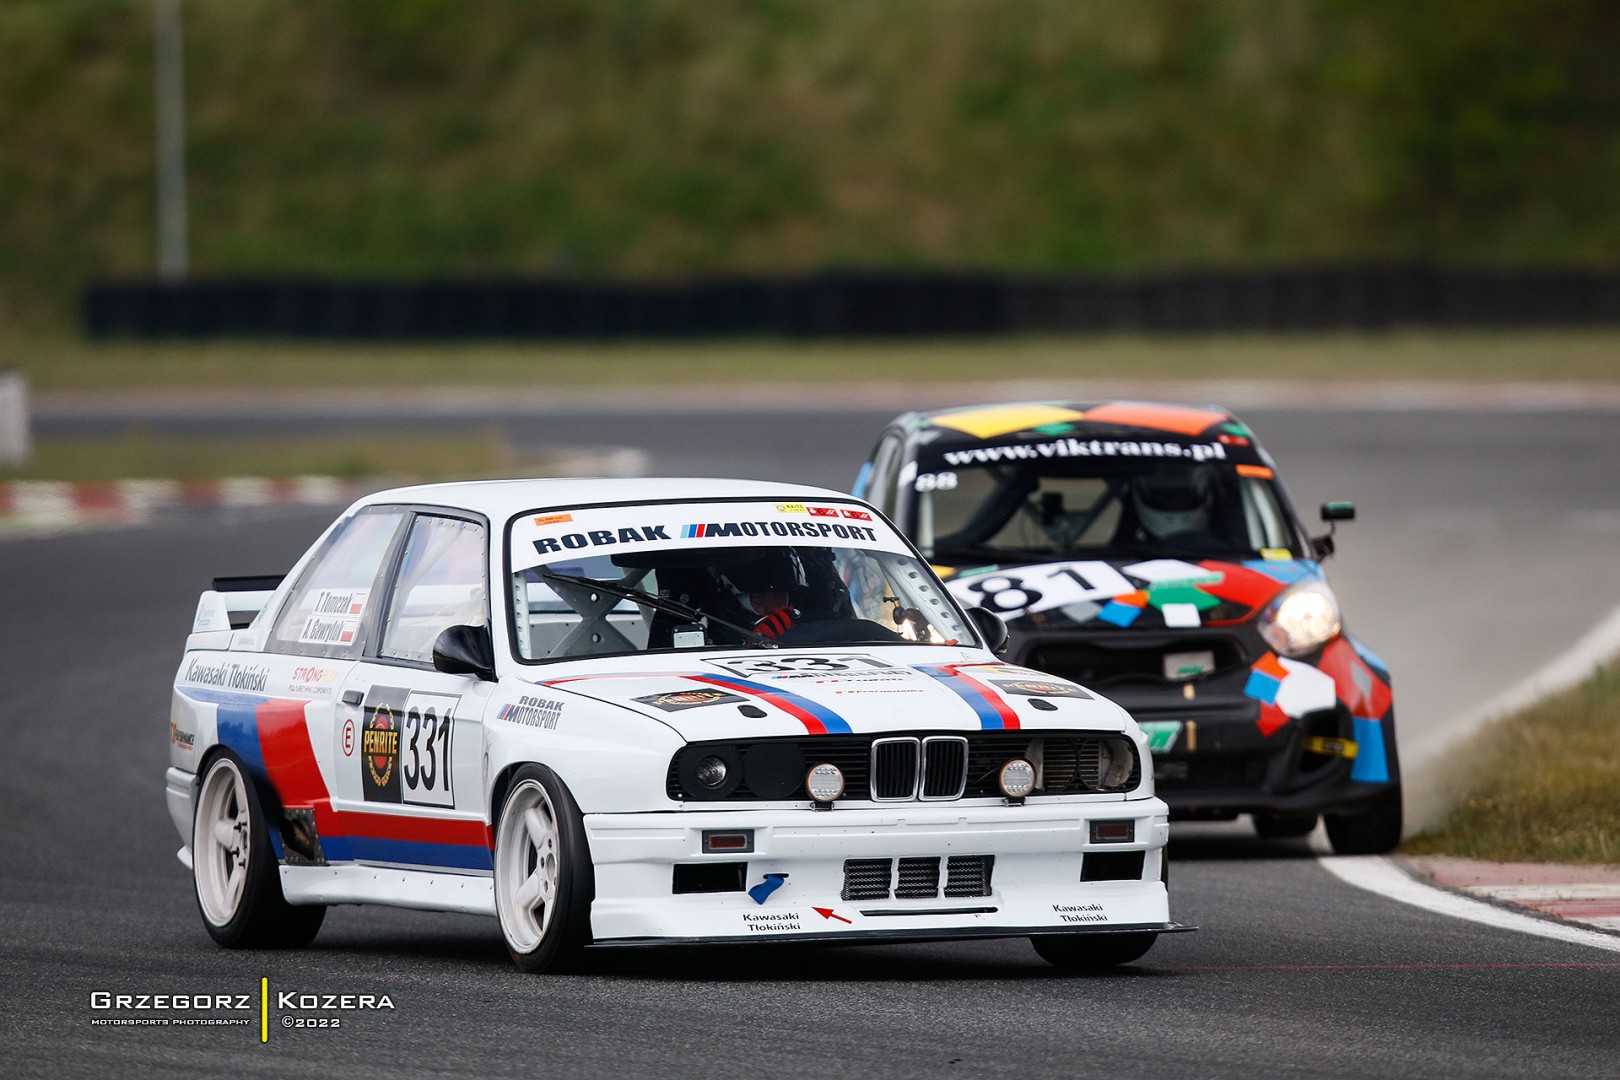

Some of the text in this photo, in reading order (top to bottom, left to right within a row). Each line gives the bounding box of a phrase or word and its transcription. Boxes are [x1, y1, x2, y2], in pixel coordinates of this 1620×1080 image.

[943, 438, 1227, 463] www.viktrans.pl
[914, 472, 958, 492] 88
[532, 521, 878, 555] ROBAK MOTORSPORT
[967, 565, 1097, 613] 81
[320, 592, 354, 614] Tomczak
[184, 657, 271, 692] Kawasaki Tłokiński
[727, 656, 895, 673] 331
[518, 695, 565, 711] ROBAK
[503, 703, 563, 730] MOTORSPORT
[345, 727, 352, 749] E
[363, 729, 399, 754] PENRITE
[403, 705, 454, 792] 331
[742, 912, 800, 922] Kawasaki
[1052, 903, 1104, 913] Kawasaki
[1060, 913, 1109, 923] Tłokiński
[747, 922, 801, 932] Tłokiński
